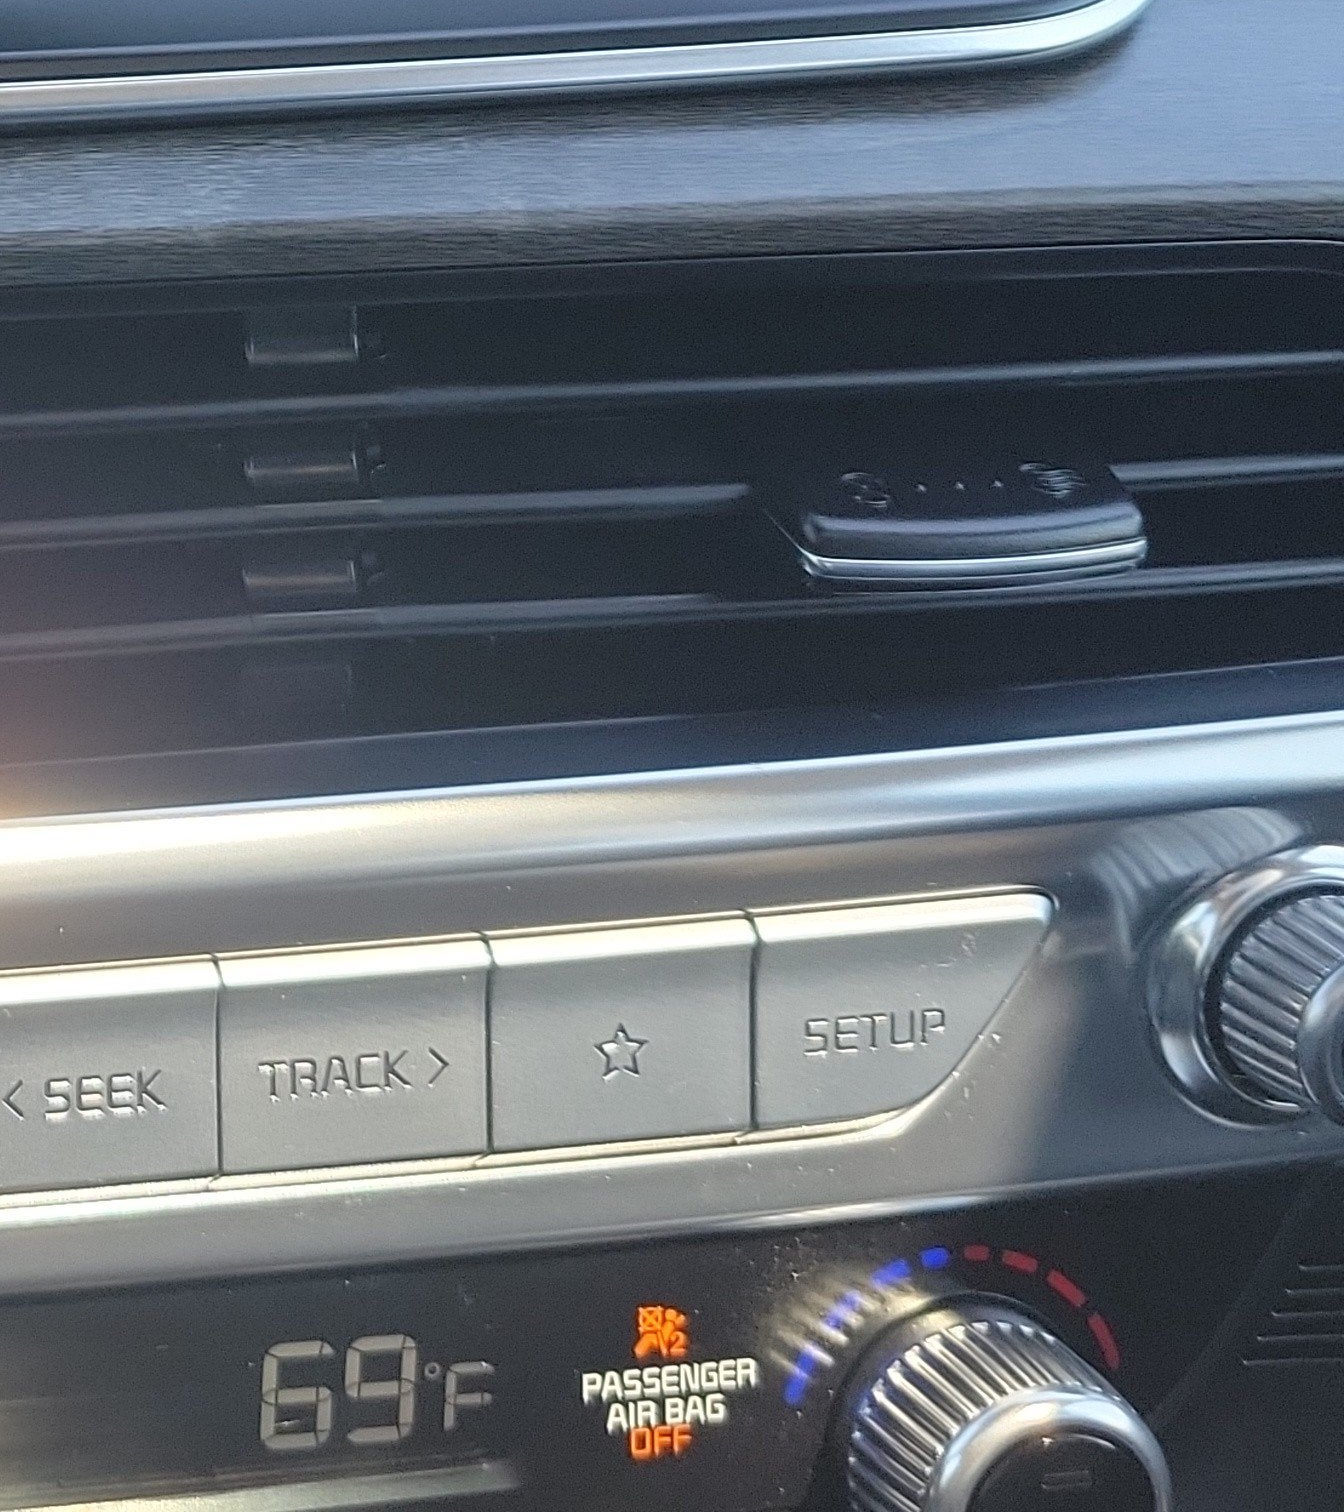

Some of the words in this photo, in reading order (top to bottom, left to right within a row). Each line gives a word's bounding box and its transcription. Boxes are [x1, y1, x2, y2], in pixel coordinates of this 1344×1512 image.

[803, 1007, 946, 1058] SETUP
[43, 1069, 167, 1122] SEEK
[258, 1050, 412, 1103] TRACK
[582, 1357, 760, 1405] PASSENGER
[606, 1399, 659, 1435] AIR
[665, 1393, 727, 1426] BAG
[629, 1423, 693, 1461] OFF
